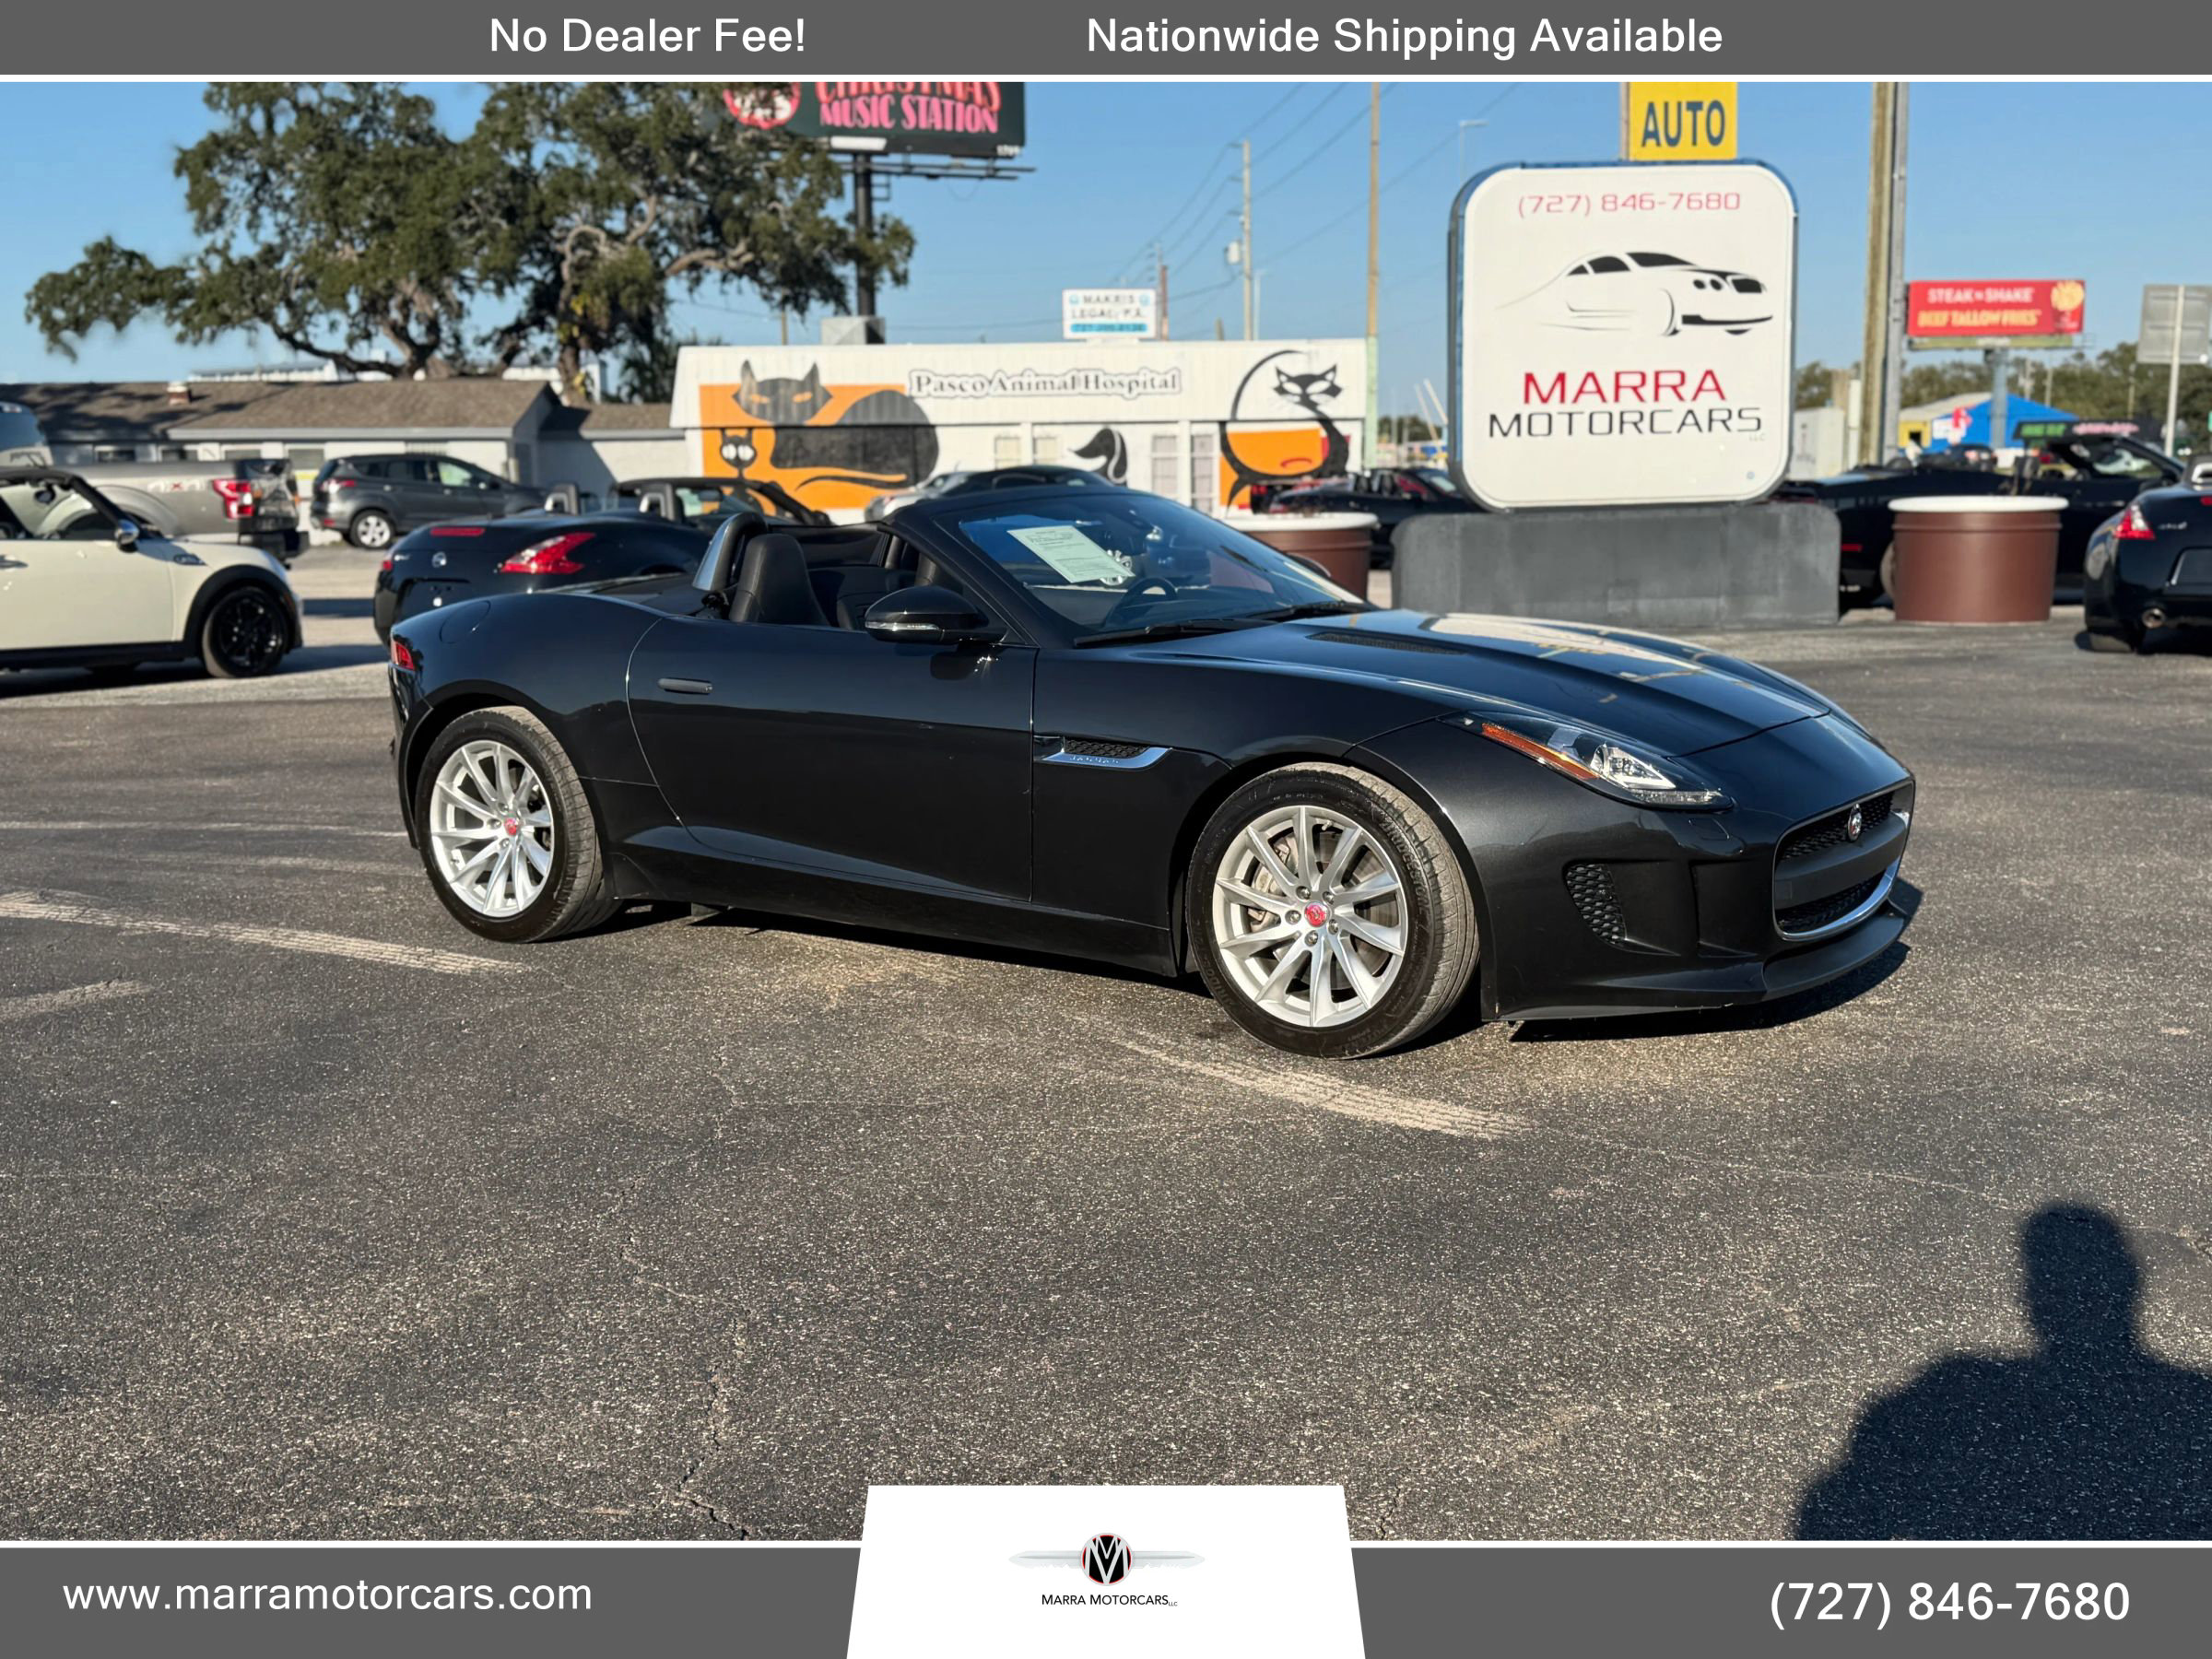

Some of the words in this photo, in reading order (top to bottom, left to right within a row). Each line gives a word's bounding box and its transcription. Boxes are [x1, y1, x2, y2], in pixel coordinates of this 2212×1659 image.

[820, 94, 896, 128] MUSIC
[900, 94, 999, 135] STATION
[1641, 100, 1726, 147] AUTO
[1518, 194, 1592, 217] (727)
[1601, 192, 1741, 212] 846-7680
[914, 373, 987, 394] Pasco
[990, 371, 1077, 392] Animal
[1082, 371, 1178, 397] Hospital
[1523, 368, 1727, 406] MARRA
[1488, 407, 1762, 439] MOTORCARS
